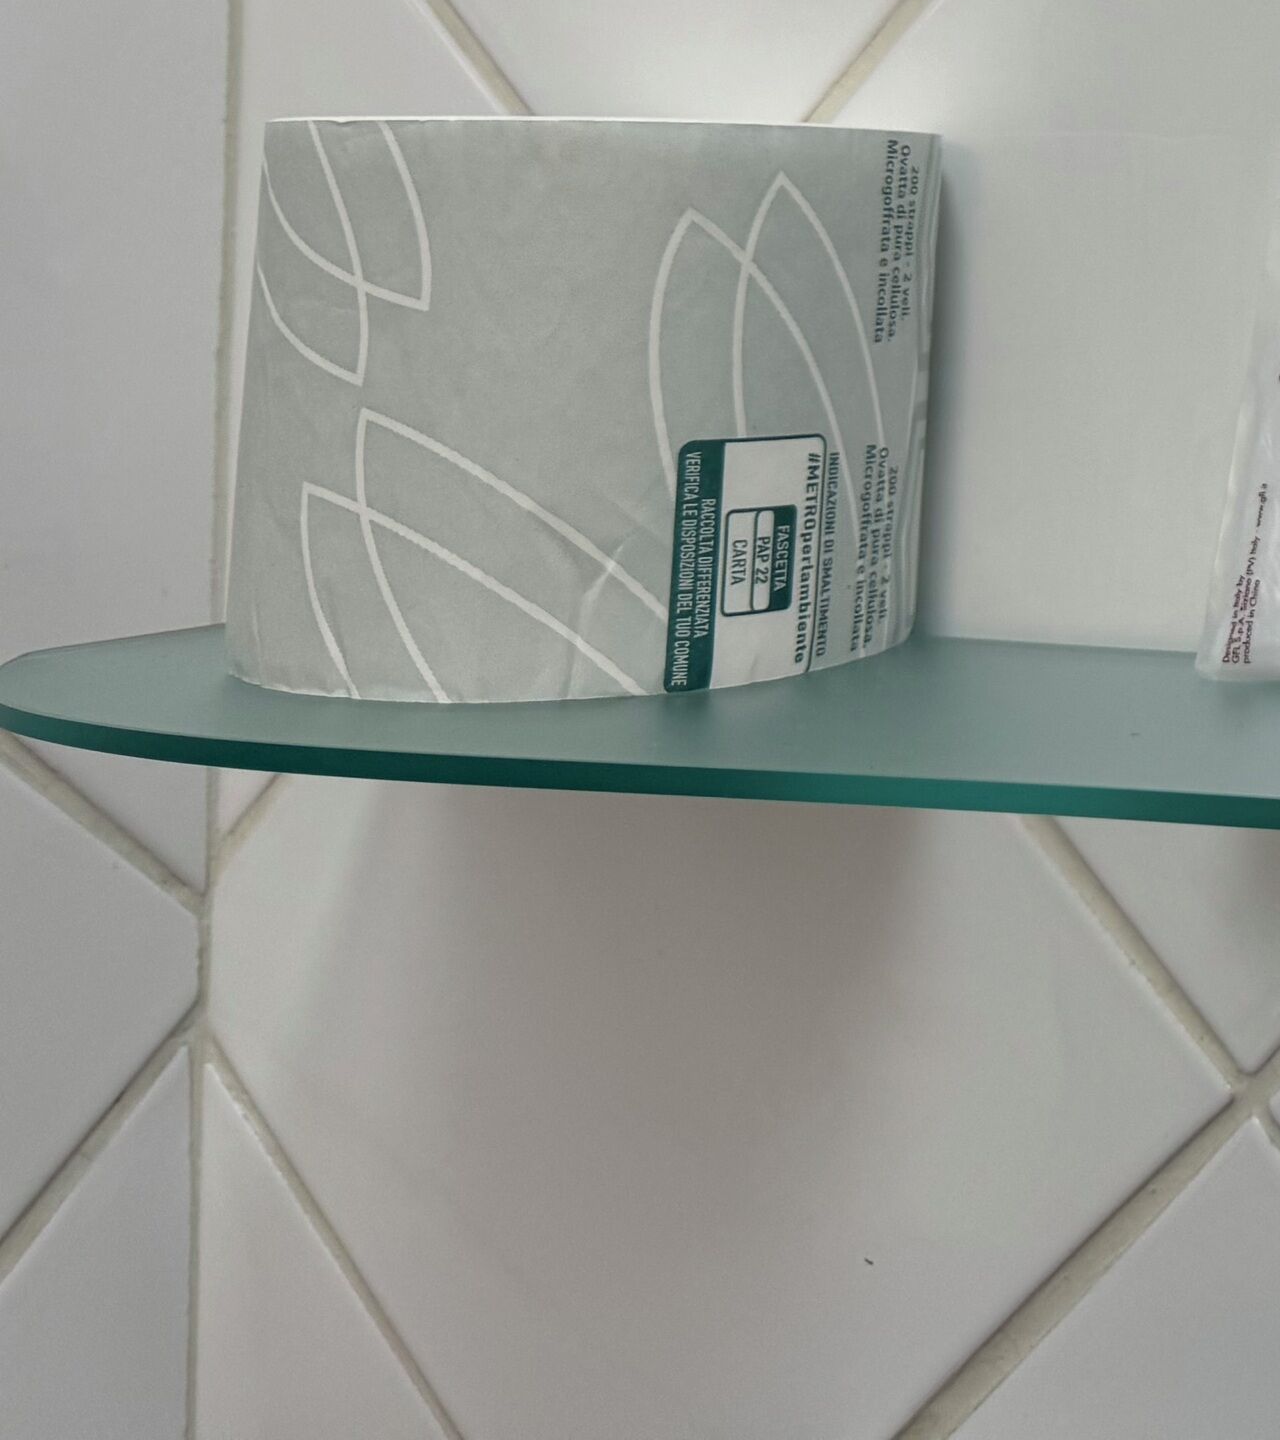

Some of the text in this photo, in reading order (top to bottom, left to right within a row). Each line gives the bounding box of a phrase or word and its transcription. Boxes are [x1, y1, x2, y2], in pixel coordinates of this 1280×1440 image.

[910, 166, 920, 195] 200
[874, 139, 899, 343] Microgoffrata e incollata
[888, 145, 911, 342] Ovatta di pura cellulosa.
[903, 200, 916, 257] strappi
[901, 288, 911, 321] veli.
[887, 466, 898, 495] 200
[730, 540, 748, 585] CARTA
[755, 536, 771, 584] PAP 22
[774, 525, 790, 591] FASCETTA
[794, 453, 821, 664] #METROperlambiente
[816, 452, 840, 656] INDICAZIONI DI SMALTIMENTO
[850, 445, 877, 652] Microgoffrata e incollata
[863, 447, 889, 649] Ovatta di pura cellulosa.
[880, 501, 896, 558] strappi
[671, 452, 701, 686] VERIFICA LE DISPOSIZIONI DEL TUO COMUNE
[693, 498, 716, 638] RACCOLTA DIFFERENZIATA
[881, 576, 890, 584] 2
[1232, 610, 1238, 618] in
[1242, 579, 1260, 664] produced in China
